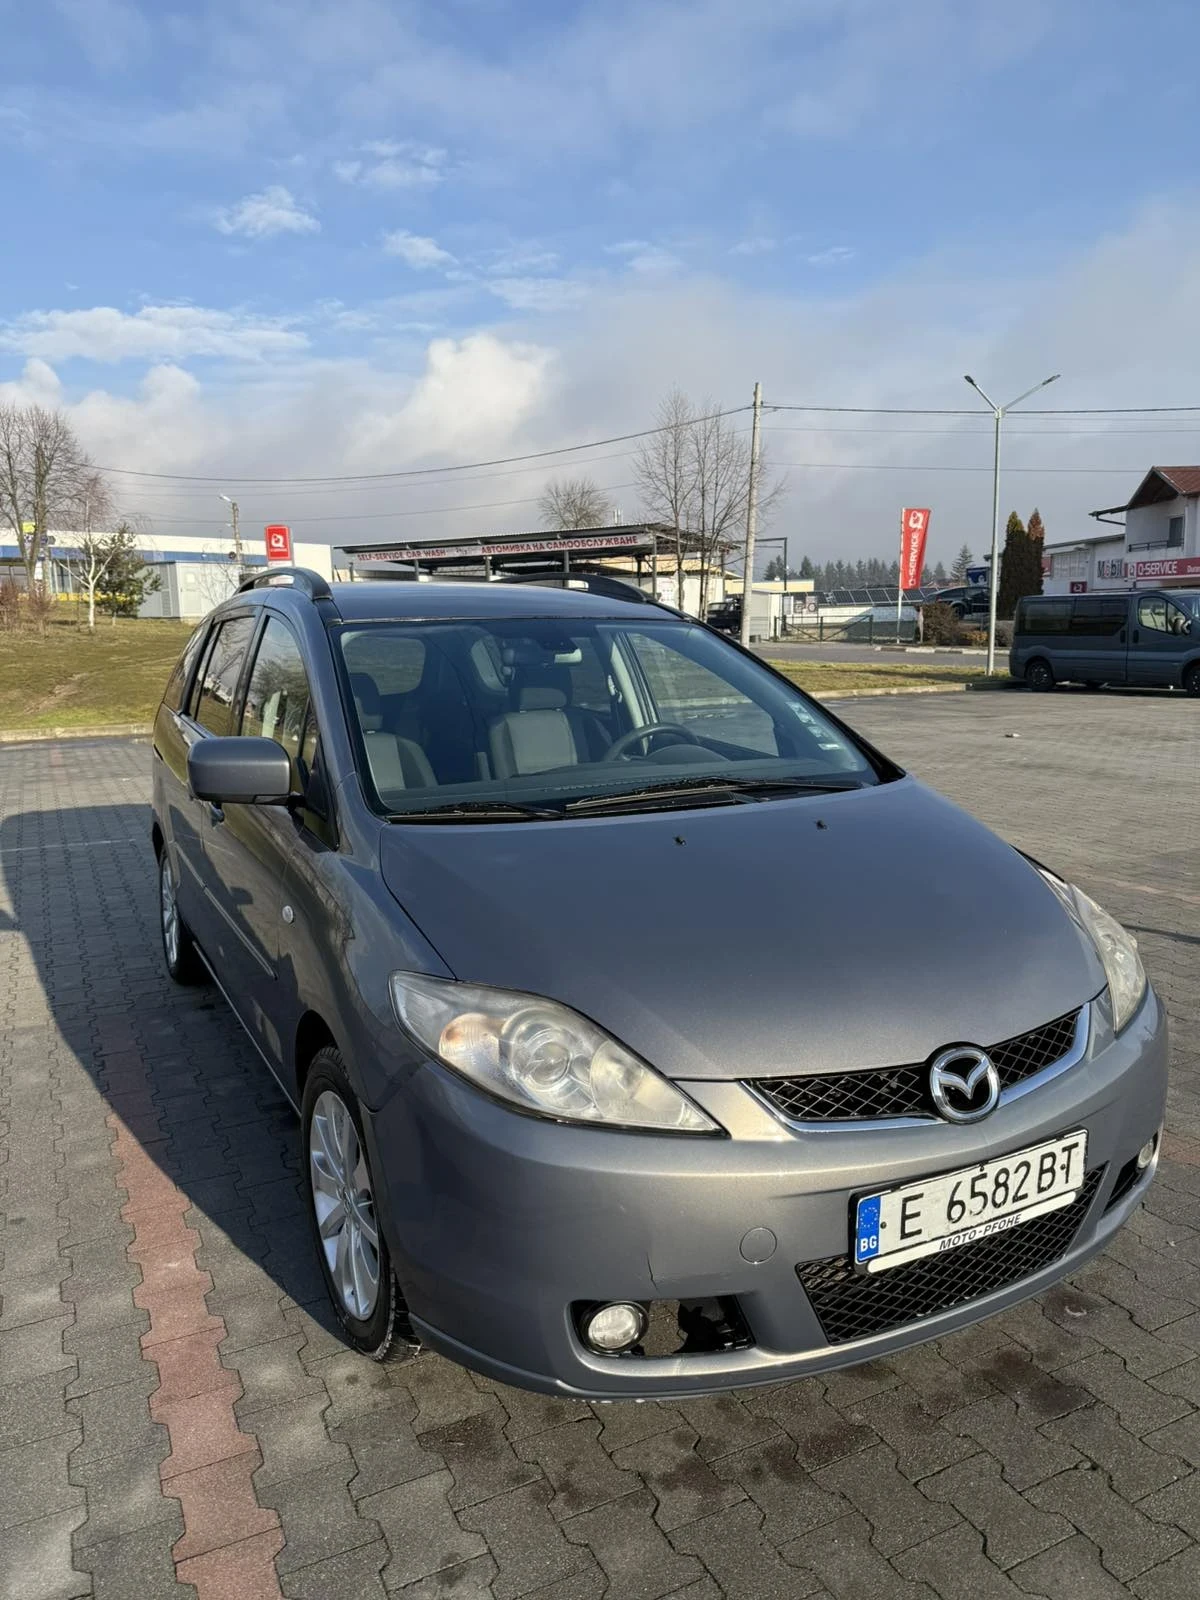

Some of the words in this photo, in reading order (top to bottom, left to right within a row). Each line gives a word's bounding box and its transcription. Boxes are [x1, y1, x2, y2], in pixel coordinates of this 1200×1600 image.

[481, 543, 532, 555] АВТОМИВКА
[533, 543, 545, 551] НА
[546, 535, 639, 550] САМООБСЛУЖВАНЕ
[357, 551, 404, 561] SELF-SERVICE
[406, 551, 420, 559] CAR
[423, 549, 447, 557] WASH
[900, 1192, 924, 1241] E
[860, 1235, 878, 1252] BG
